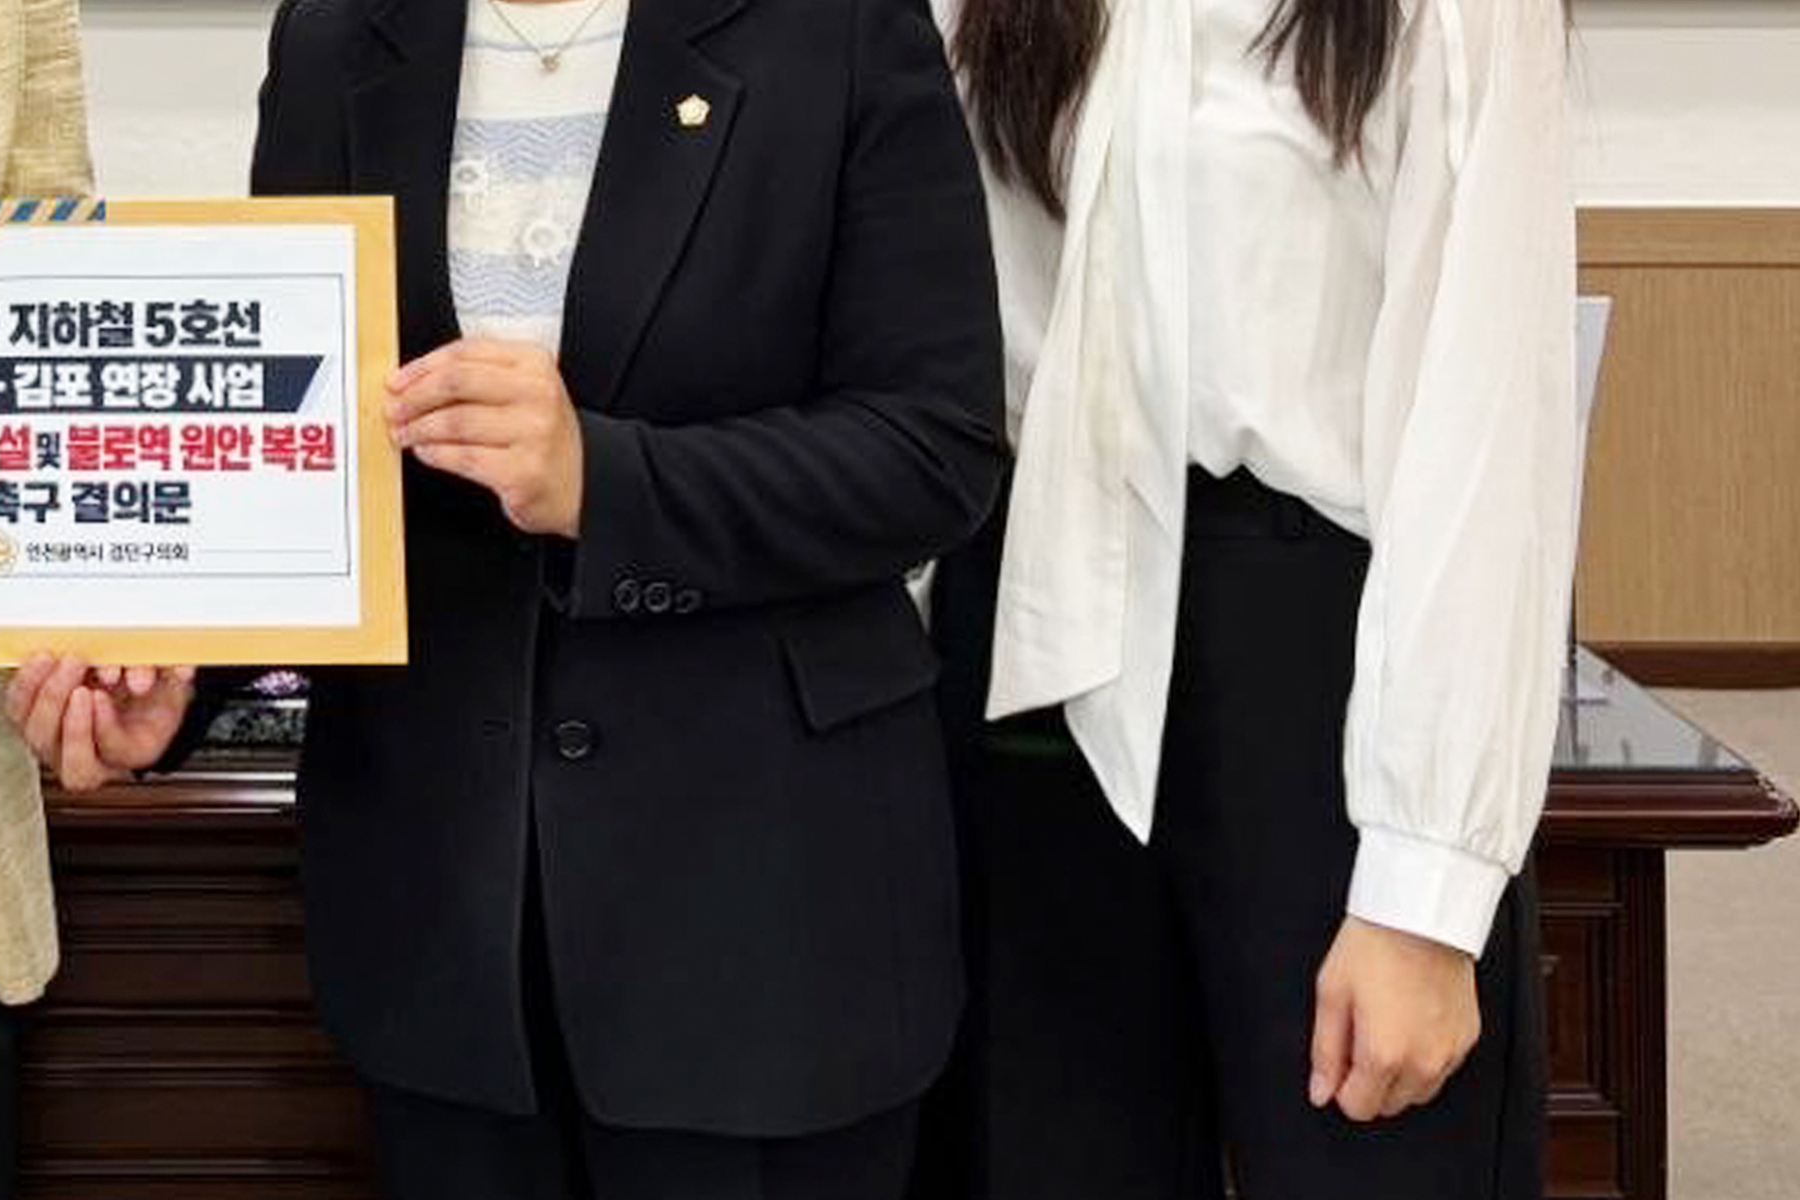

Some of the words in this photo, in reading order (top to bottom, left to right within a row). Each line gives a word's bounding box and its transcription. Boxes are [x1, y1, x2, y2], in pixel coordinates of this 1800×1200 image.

[8, 300, 134, 350] 지하철
[144, 299, 262, 349] 5호선
[100, 361, 181, 409] 연장
[185, 361, 265, 409] 사업
[34, 430, 62, 471] 및
[66, 423, 171, 472] 불로역
[180, 423, 254, 472] 원안
[261, 423, 337, 472] 복원
[70, 480, 192, 525] 결의문
[26, 541, 104, 563] 인천광역시
[108, 541, 190, 562] 검단구의회
